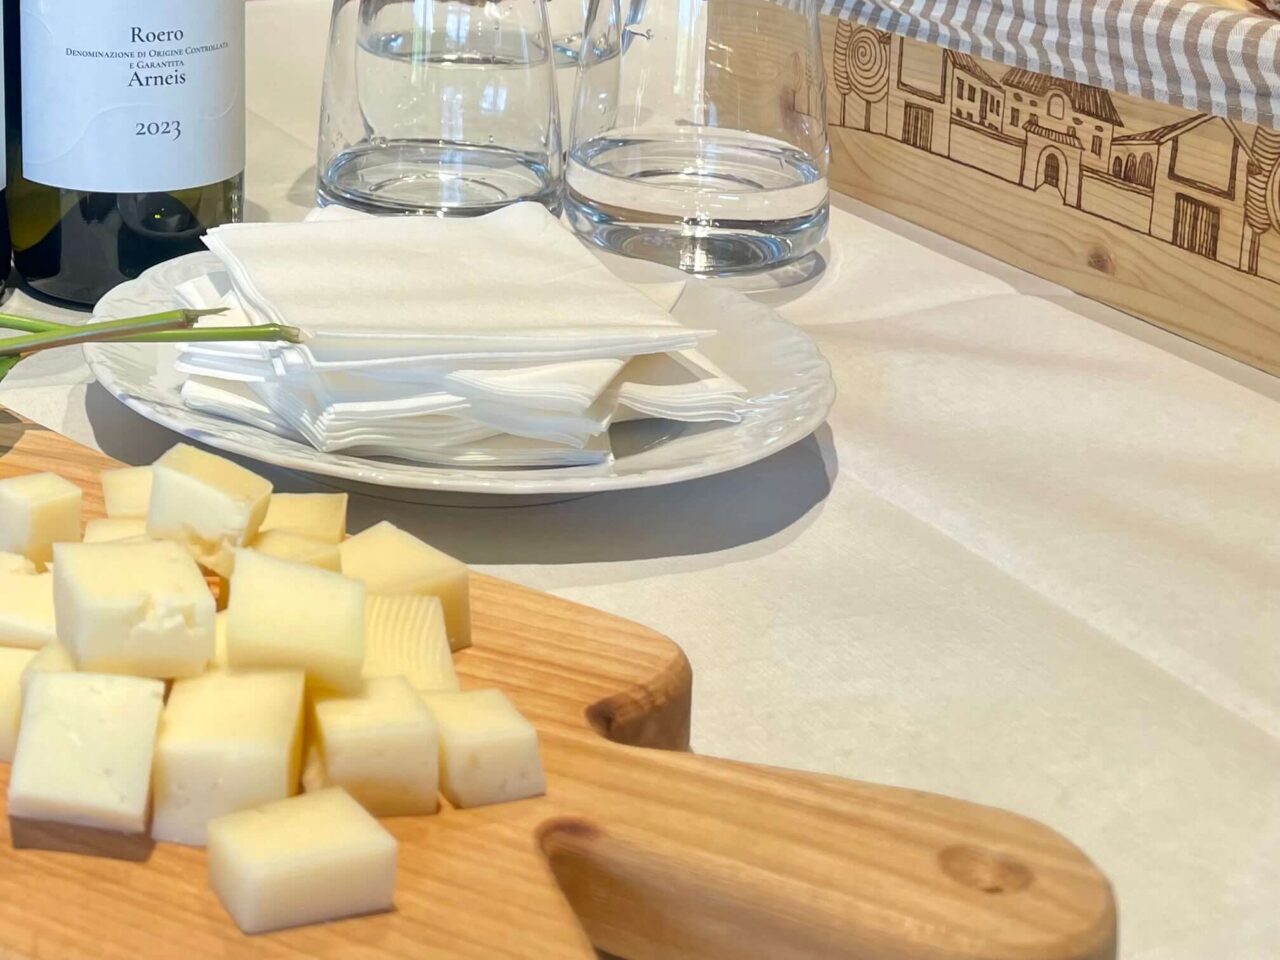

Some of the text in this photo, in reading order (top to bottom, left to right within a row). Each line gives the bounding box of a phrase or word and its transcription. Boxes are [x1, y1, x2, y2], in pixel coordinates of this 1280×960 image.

[130, 26, 184, 43] Roero
[128, 69, 187, 88] Arneis
[135, 120, 182, 141] 2023
